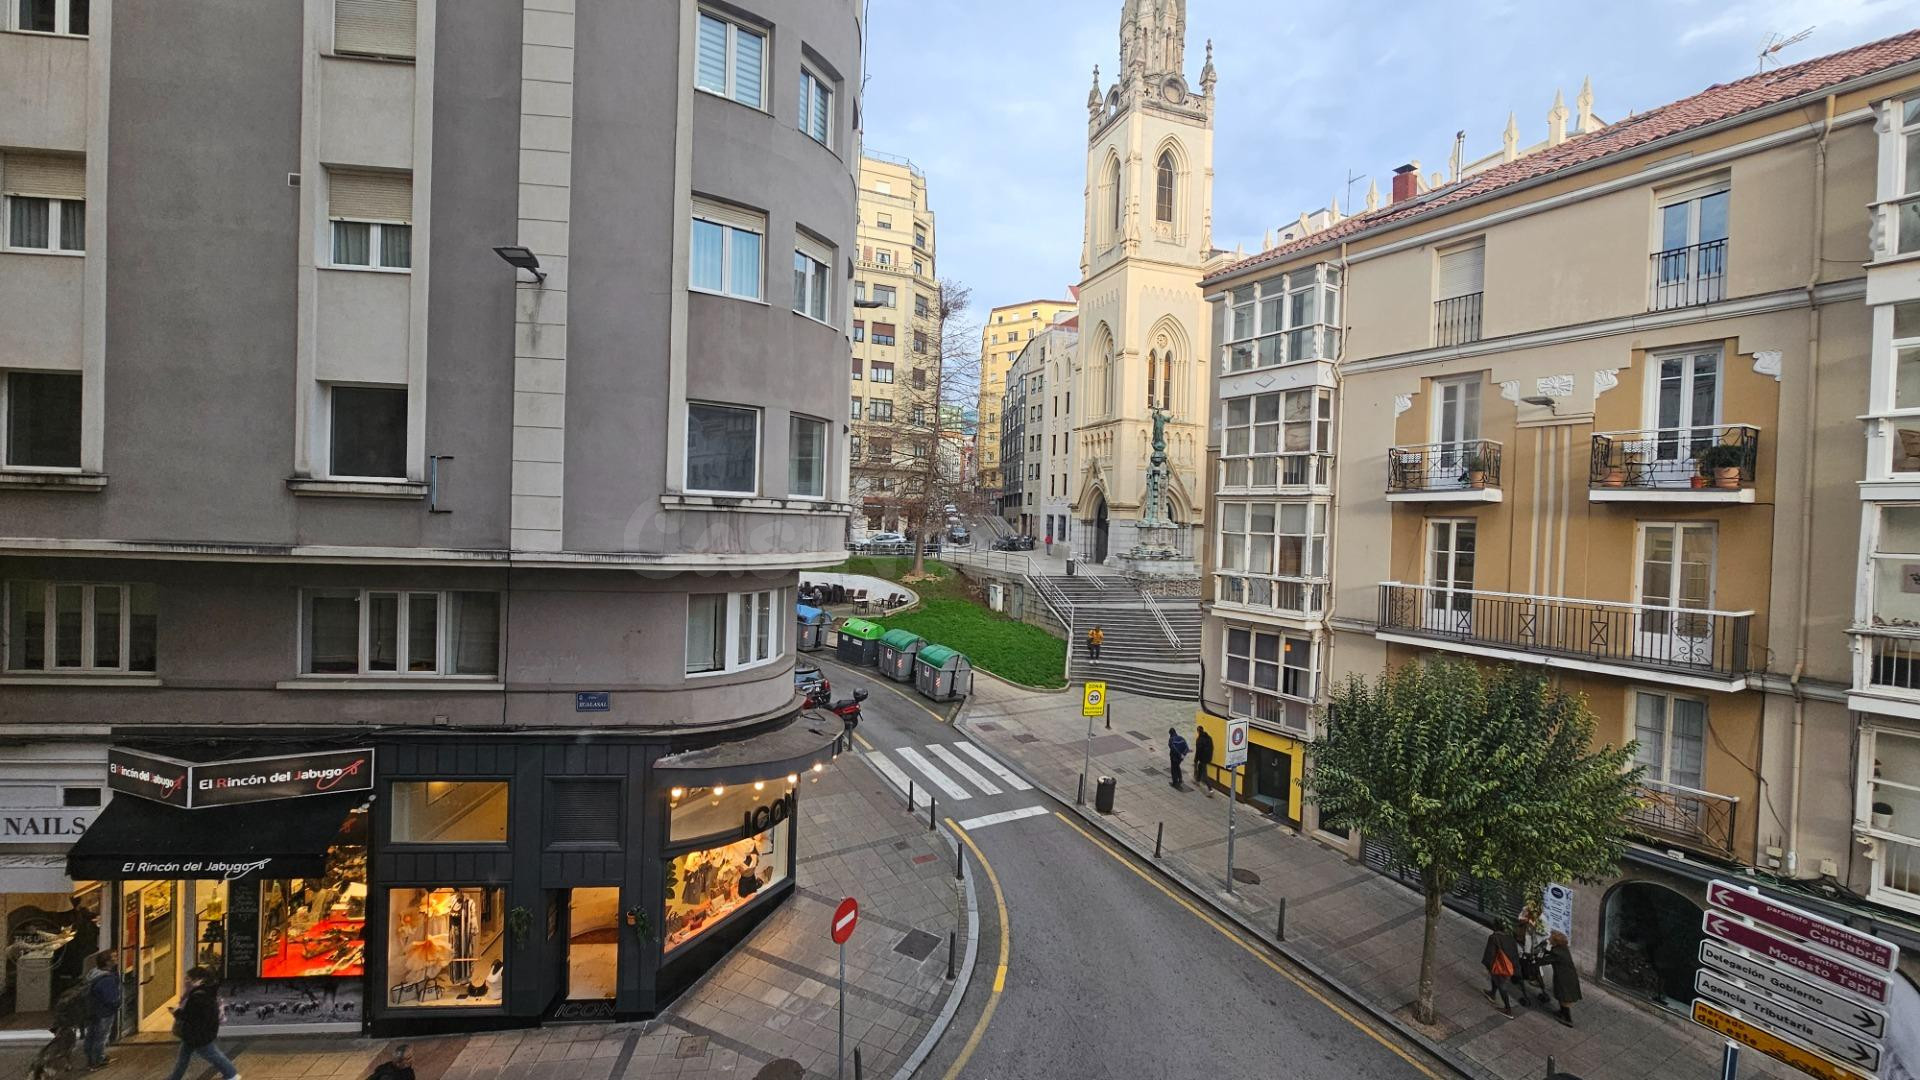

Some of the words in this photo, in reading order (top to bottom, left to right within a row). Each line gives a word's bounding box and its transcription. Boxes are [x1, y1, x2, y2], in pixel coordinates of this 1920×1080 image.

[110, 763, 116, 774] El
[139, 770, 150, 781] del
[199, 779, 212, 790] El
[216, 774, 266, 788] Rincón
[270, 772, 291, 782] del
[294, 767, 342, 781] Jabugo
[3, 816, 86, 835] NAILS
[122, 862, 135, 872] El
[137, 862, 180, 872] Rincón
[183, 862, 202, 872] del
[205, 862, 250, 873] Jabugo
[1767, 905, 1808, 925] paraninfo
[1812, 920, 1871, 948] universitario
[1875, 944, 1887, 954] de
[1810, 930, 1886, 966] Cantabria
[1706, 949, 1765, 981] Delegación
[1770, 977, 1823, 1006] Gobierno
[1769, 946, 1829, 979] Modesto
[1838, 975, 1881, 1000] Tapia
[1809, 954, 1840, 971] centro
[1843, 967, 1882, 987] cultural
[1698, 1005, 1745, 1031] mercado
[1702, 979, 1746, 1005] Agencia
[1753, 1002, 1814, 1036] Tributaria
[1697, 1014, 1720, 1032] del
[1726, 1027, 1757, 1046] este
